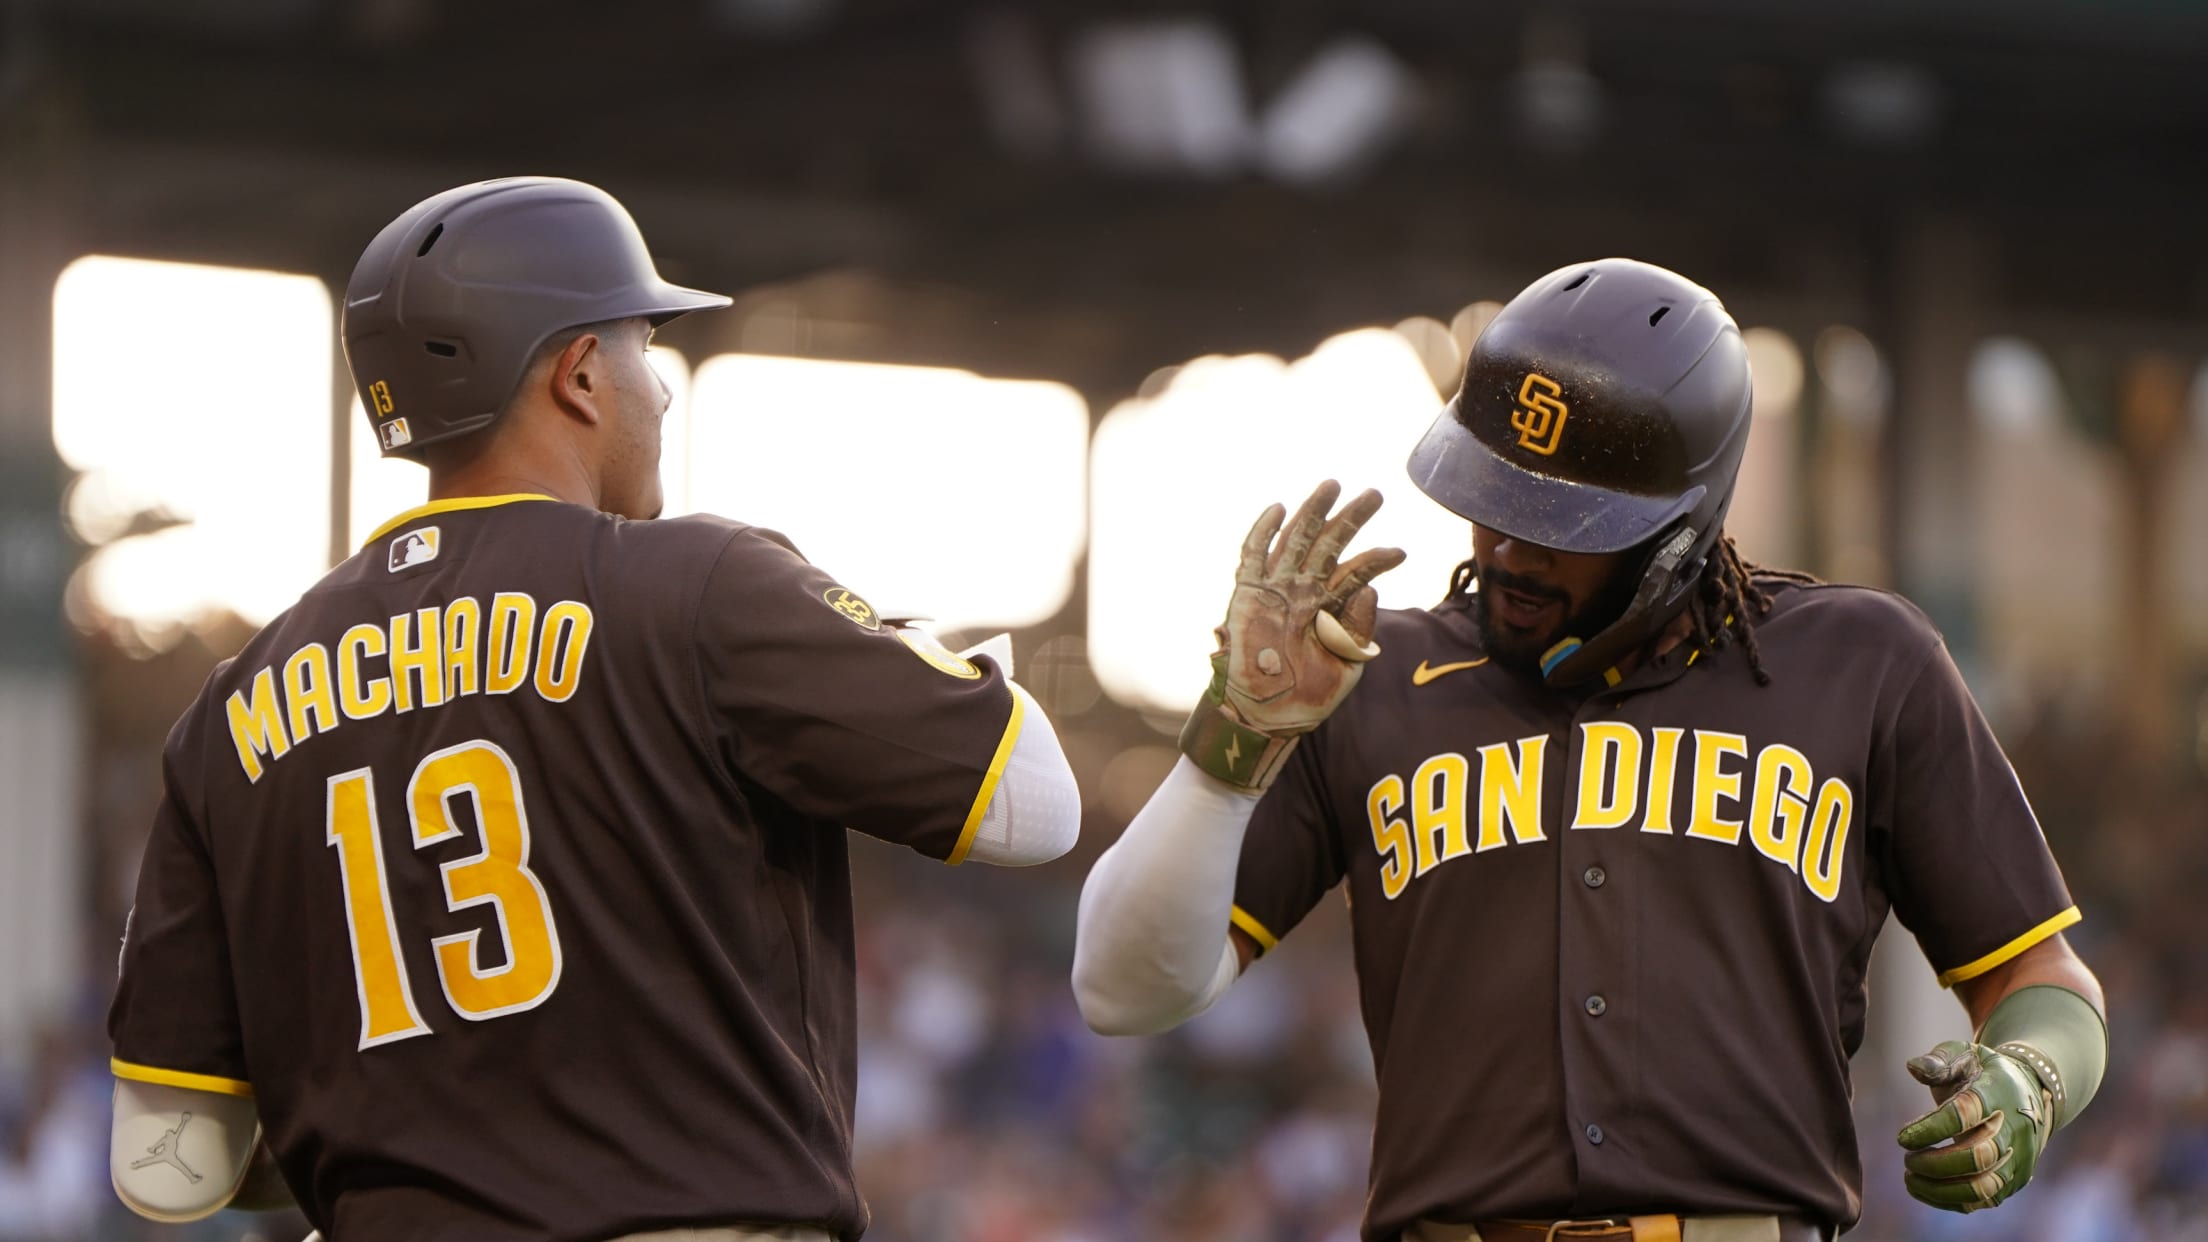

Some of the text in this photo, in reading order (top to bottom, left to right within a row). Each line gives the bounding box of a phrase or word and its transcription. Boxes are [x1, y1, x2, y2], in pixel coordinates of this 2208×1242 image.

[369, 379, 394, 418] 13
[226, 592, 594, 784] MACHADO
[833, 591, 872, 623] 35
[326, 739, 562, 1052] 13
[1367, 721, 1853, 902] SAN DIEGO
